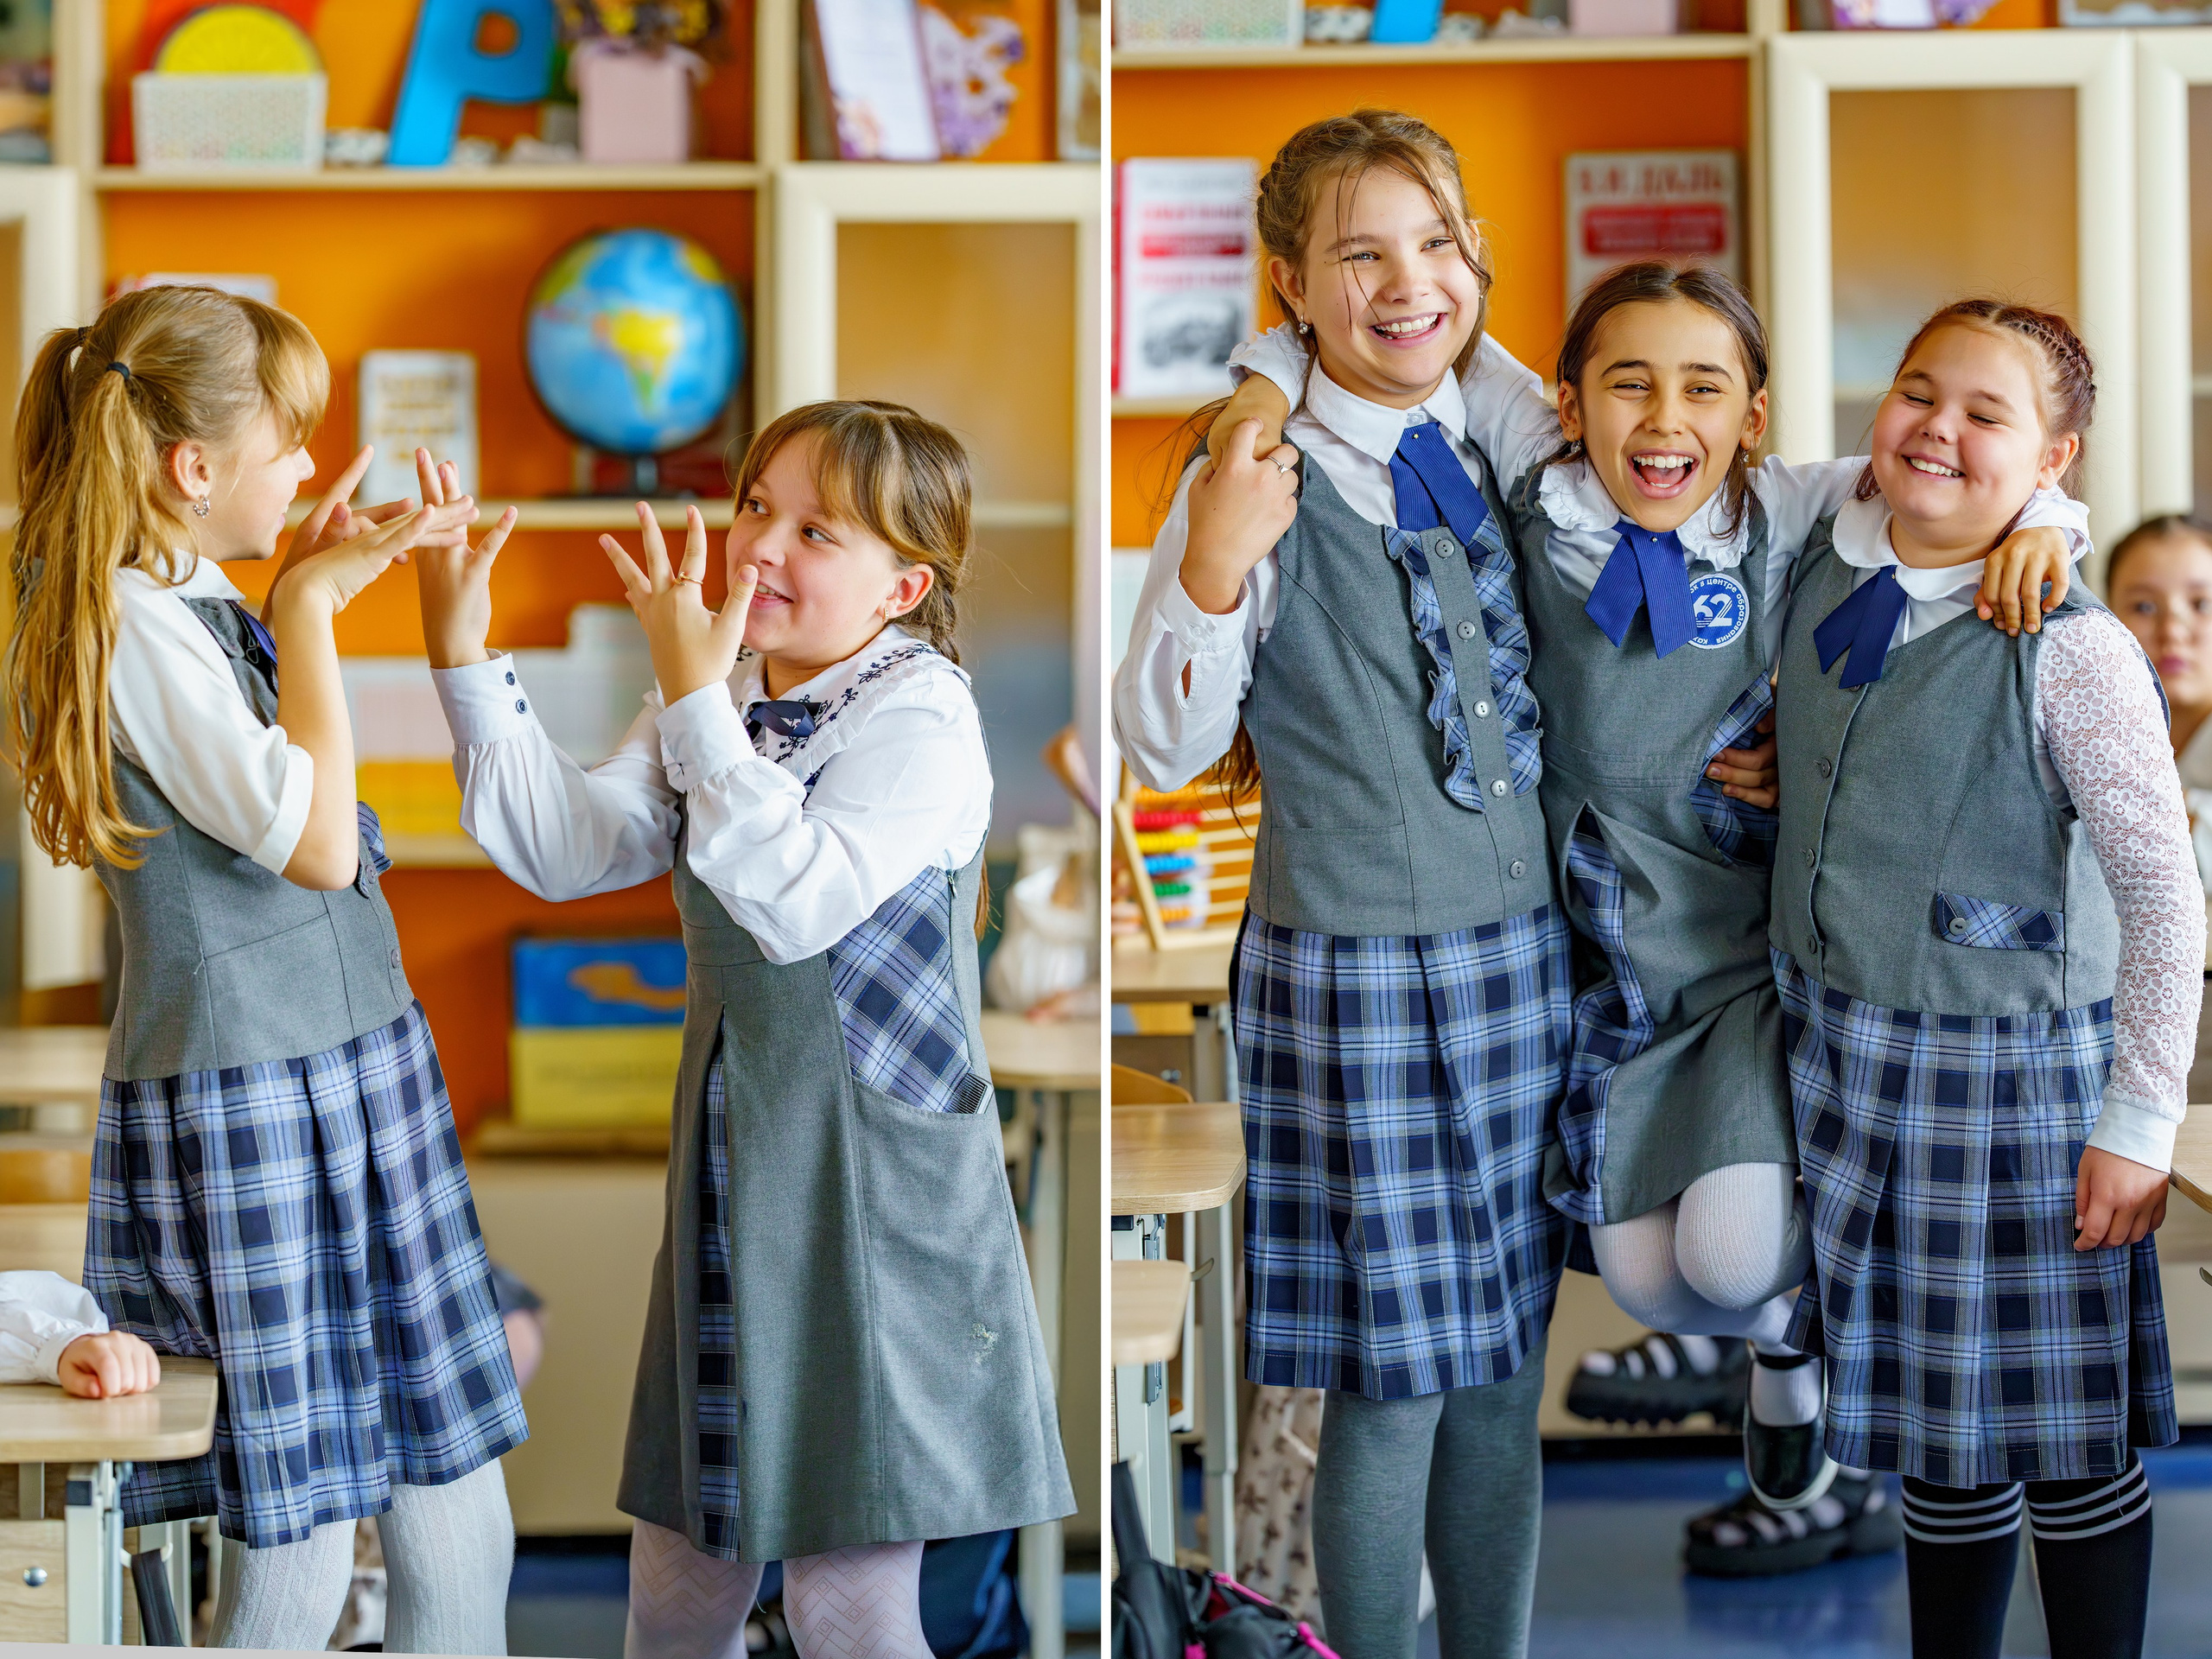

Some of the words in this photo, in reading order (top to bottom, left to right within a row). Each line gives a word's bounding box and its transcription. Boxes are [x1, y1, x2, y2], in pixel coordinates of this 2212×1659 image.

[1707, 579, 1738, 593] центре
[1693, 593, 1732, 628] 62
[1716, 594, 1746, 644] образования
